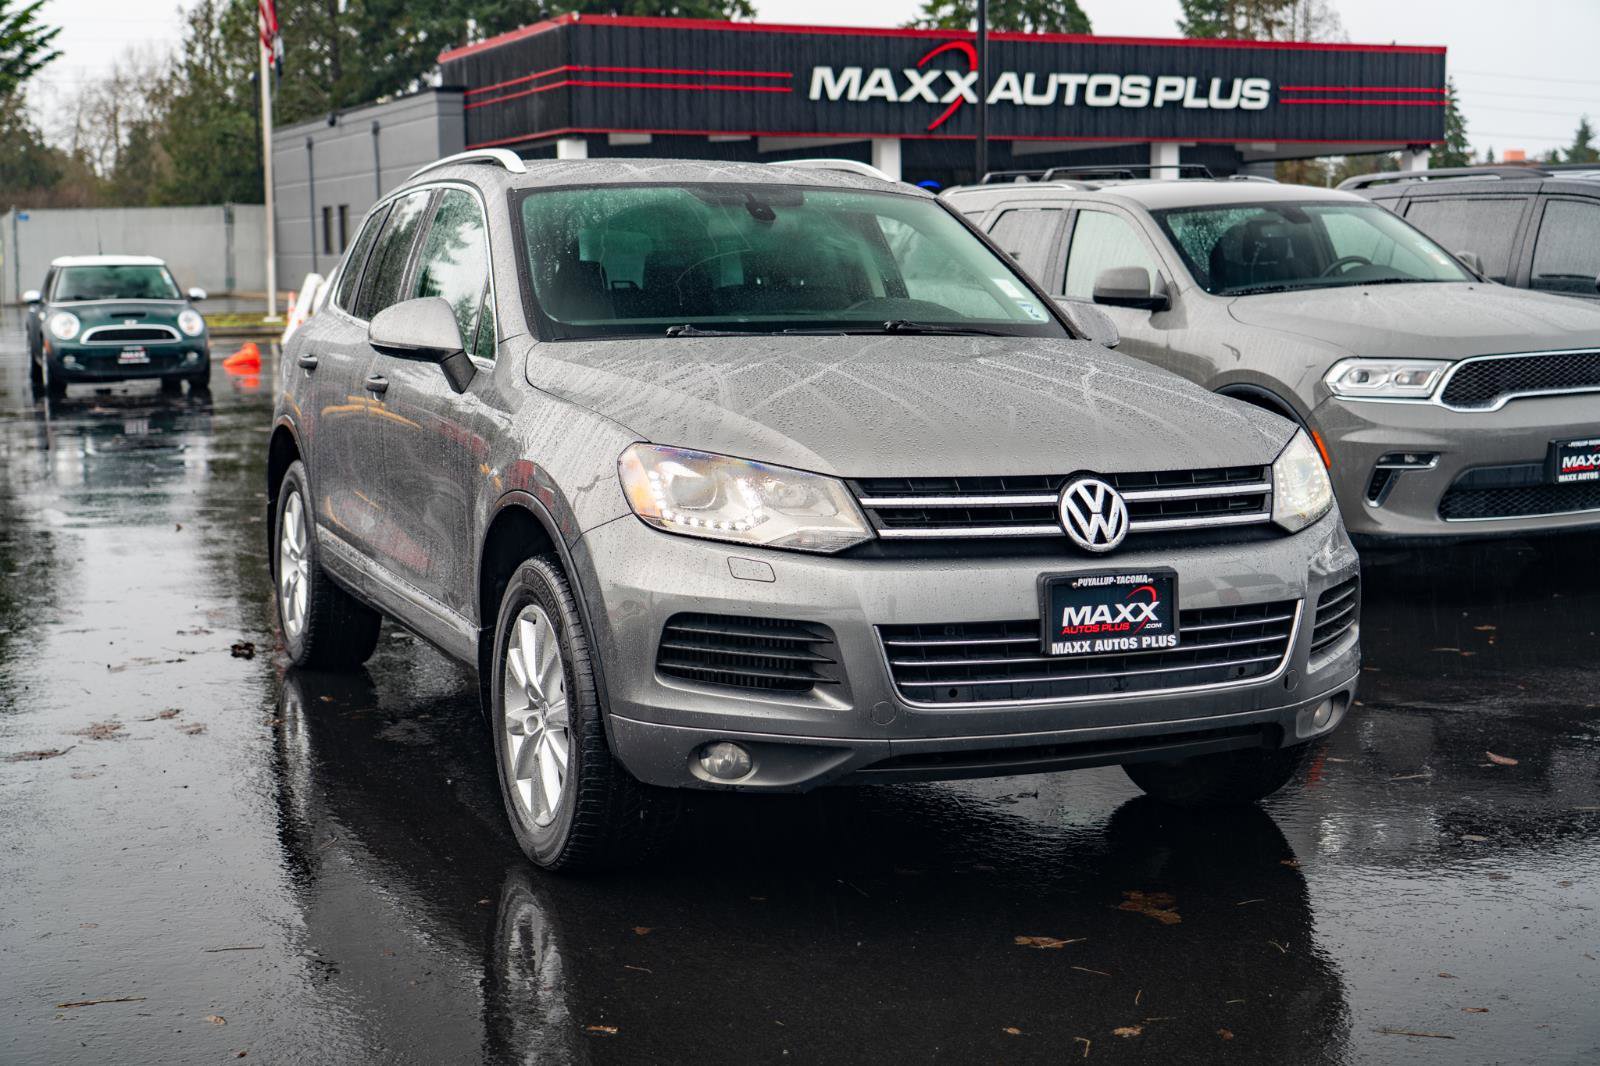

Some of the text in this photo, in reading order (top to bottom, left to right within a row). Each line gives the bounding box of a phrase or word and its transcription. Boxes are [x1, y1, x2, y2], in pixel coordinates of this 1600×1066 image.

[809, 66, 979, 104] MAXX
[1060, 478, 1129, 552] VW
[1061, 601, 1160, 627] MAXX
[1062, 622, 1130, 634] AUTOS PLUS
[1051, 634, 1177, 654] MAXX AUTOS PLUS
